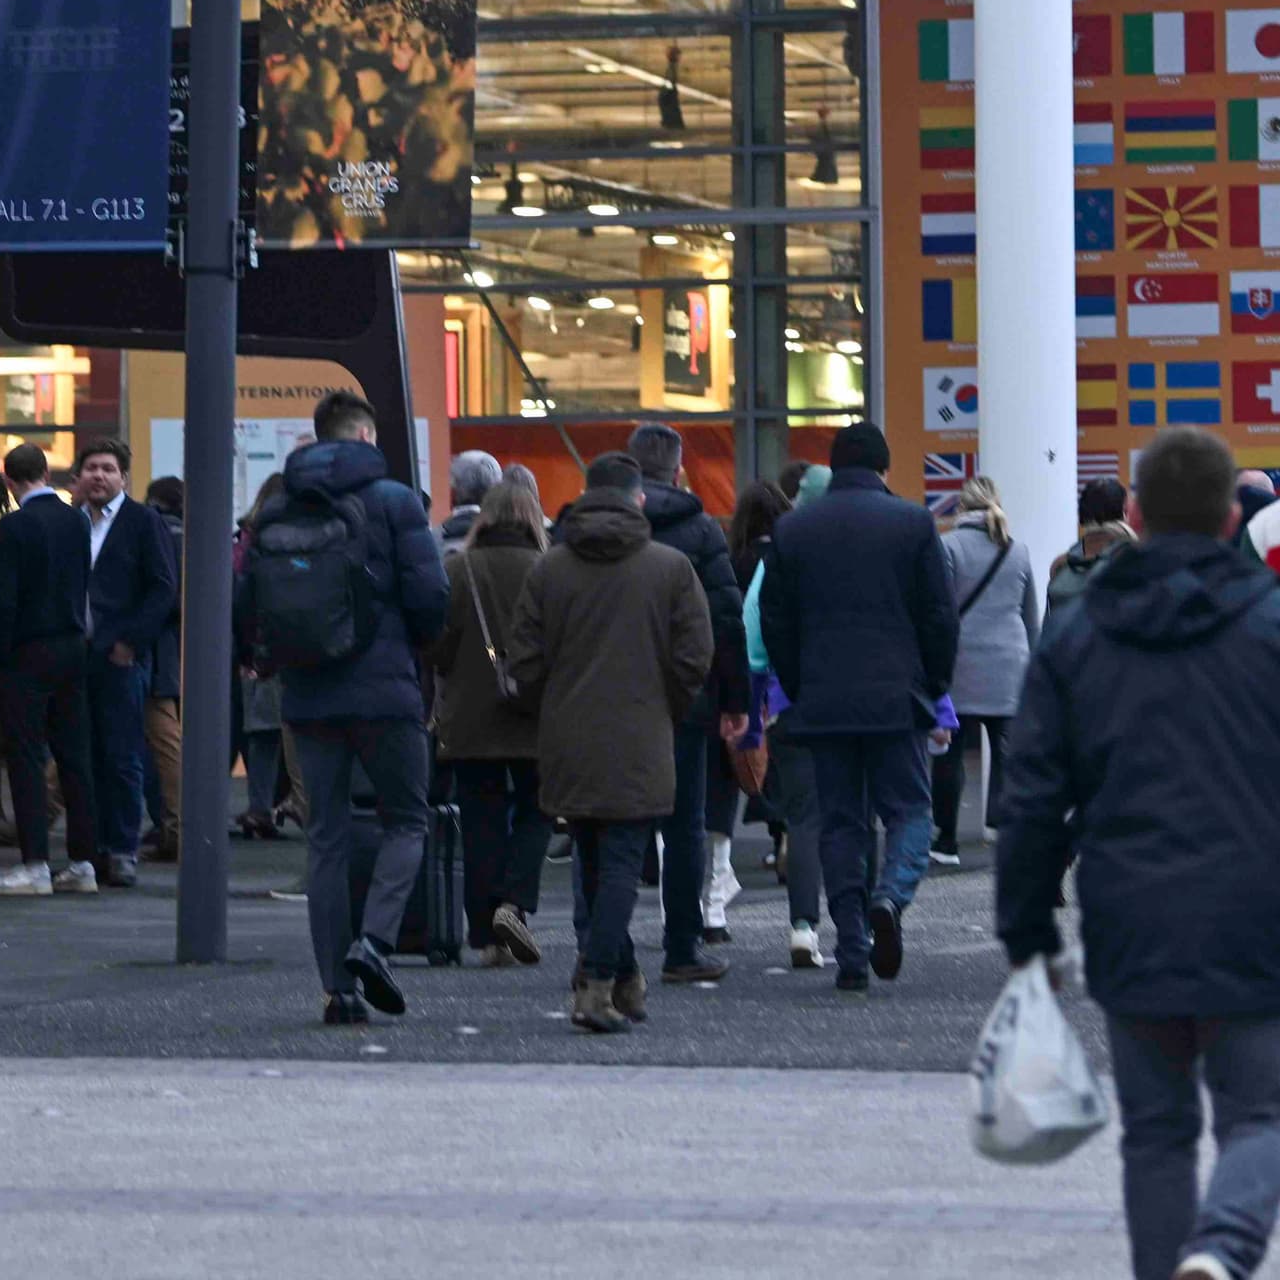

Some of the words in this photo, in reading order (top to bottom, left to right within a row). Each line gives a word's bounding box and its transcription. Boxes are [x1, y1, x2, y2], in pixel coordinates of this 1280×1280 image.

[337, 160, 391, 177] UNION
[328, 176, 399, 193] GRANDS
[40, 198, 69, 221] 7.1
[91, 197, 144, 221] G113
[341, 192, 385, 209] CRUS
